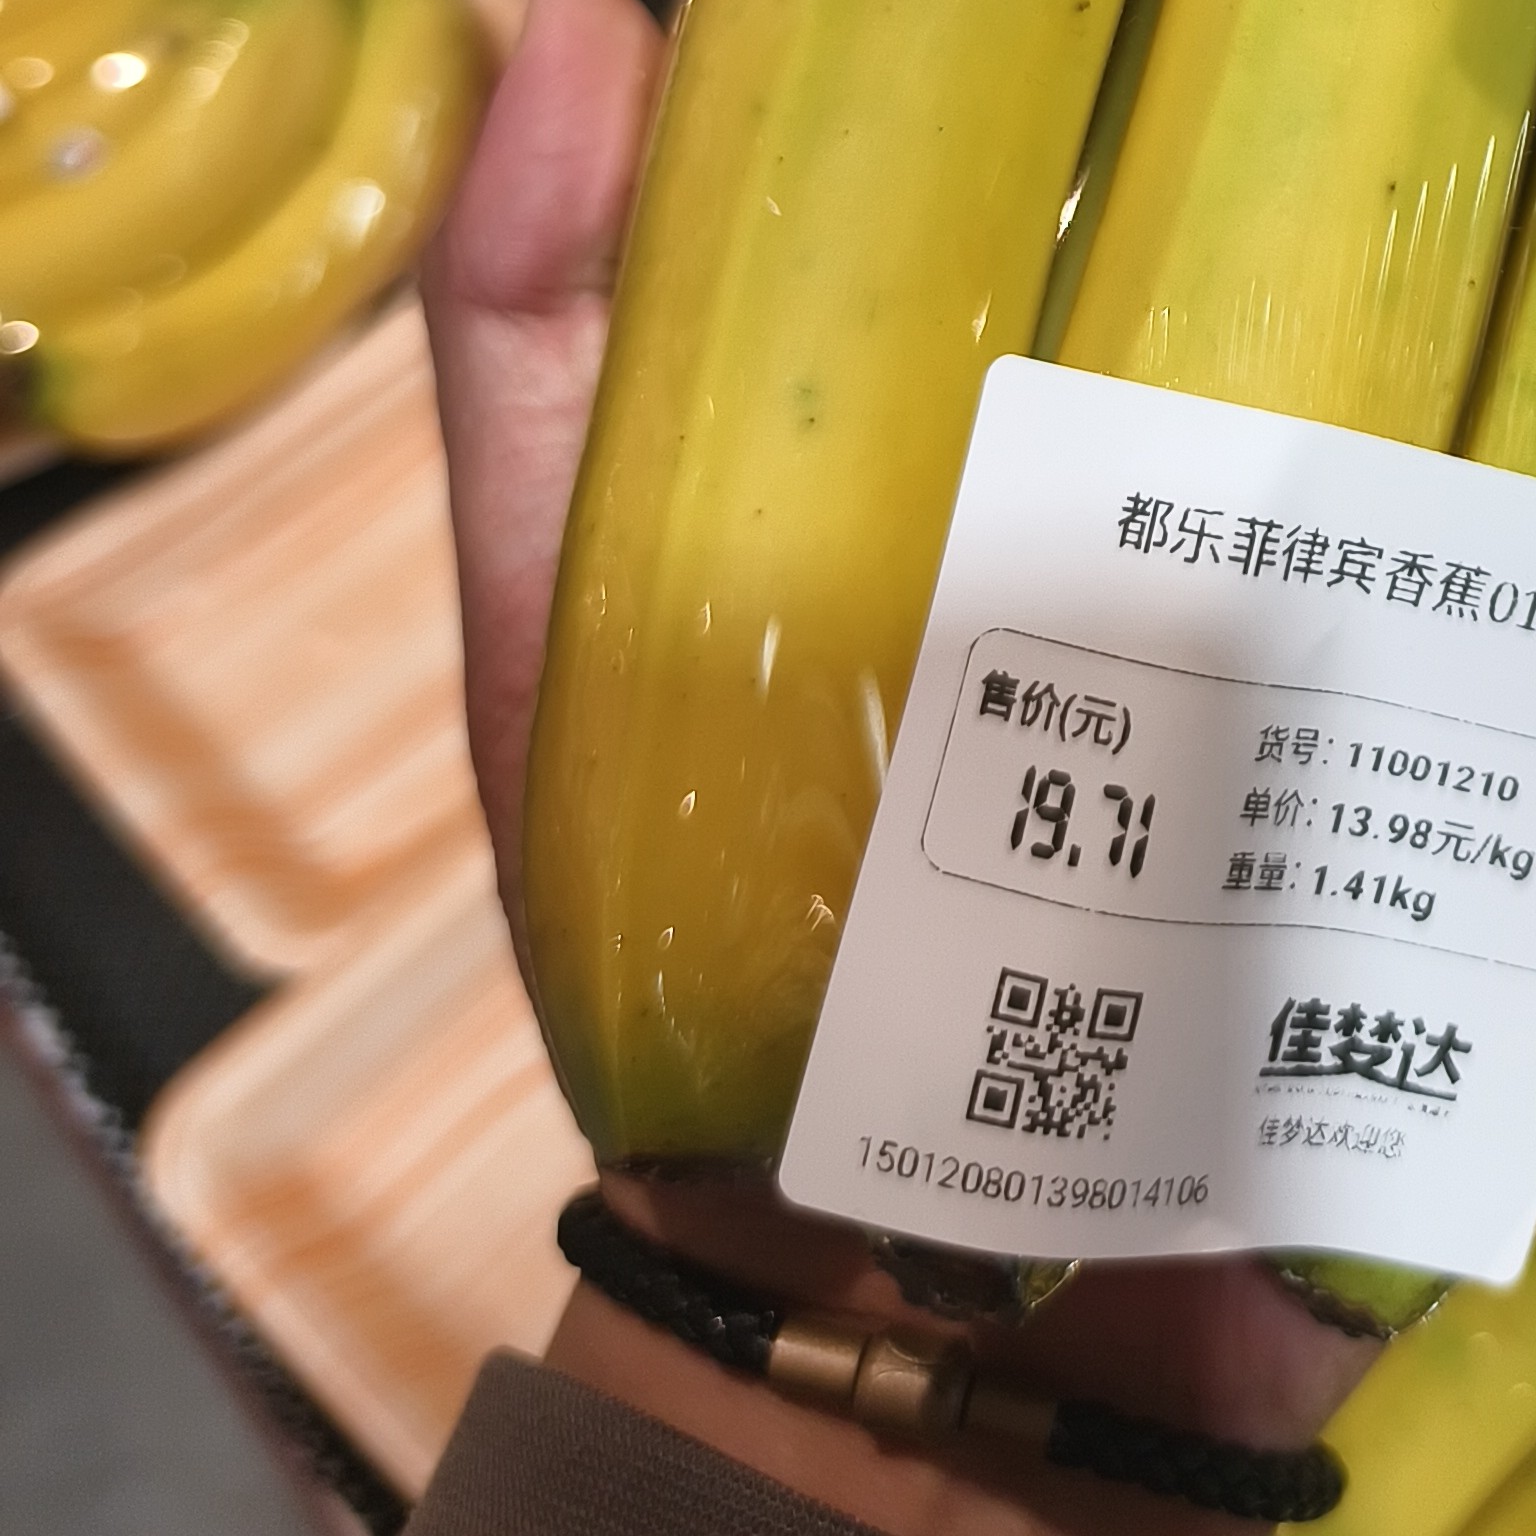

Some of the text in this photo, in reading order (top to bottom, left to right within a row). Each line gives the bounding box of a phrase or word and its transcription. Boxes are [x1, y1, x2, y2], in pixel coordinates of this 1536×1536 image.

[979, 668, 1132, 755] 售价(元)
[1010, 764, 1156, 879] 19.71
[1258, 996, 1474, 1102] 佳梦达
[859, 1135, 1210, 1210] 150120801398014106
